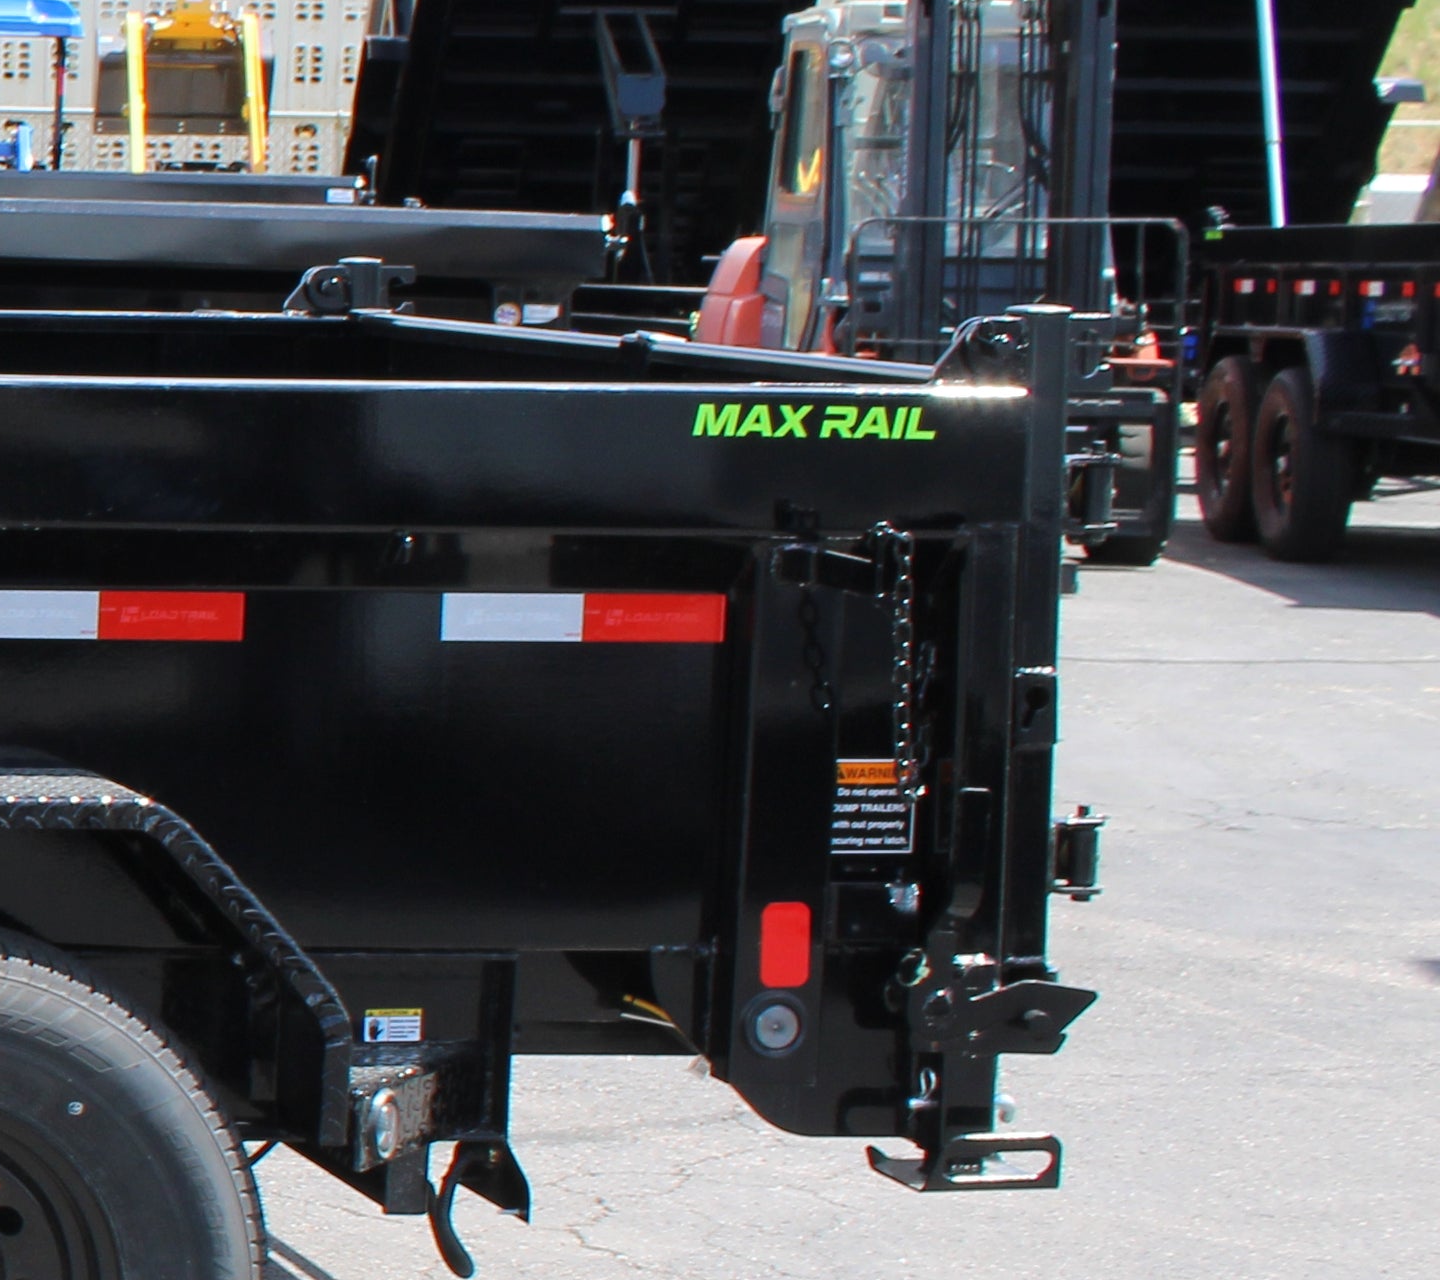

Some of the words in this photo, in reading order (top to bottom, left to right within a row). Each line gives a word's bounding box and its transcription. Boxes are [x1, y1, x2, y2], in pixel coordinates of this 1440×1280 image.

[692, 403, 814, 438] MAX
[819, 405, 936, 440] RAIL
[861, 803, 906, 812] TRAILERS
